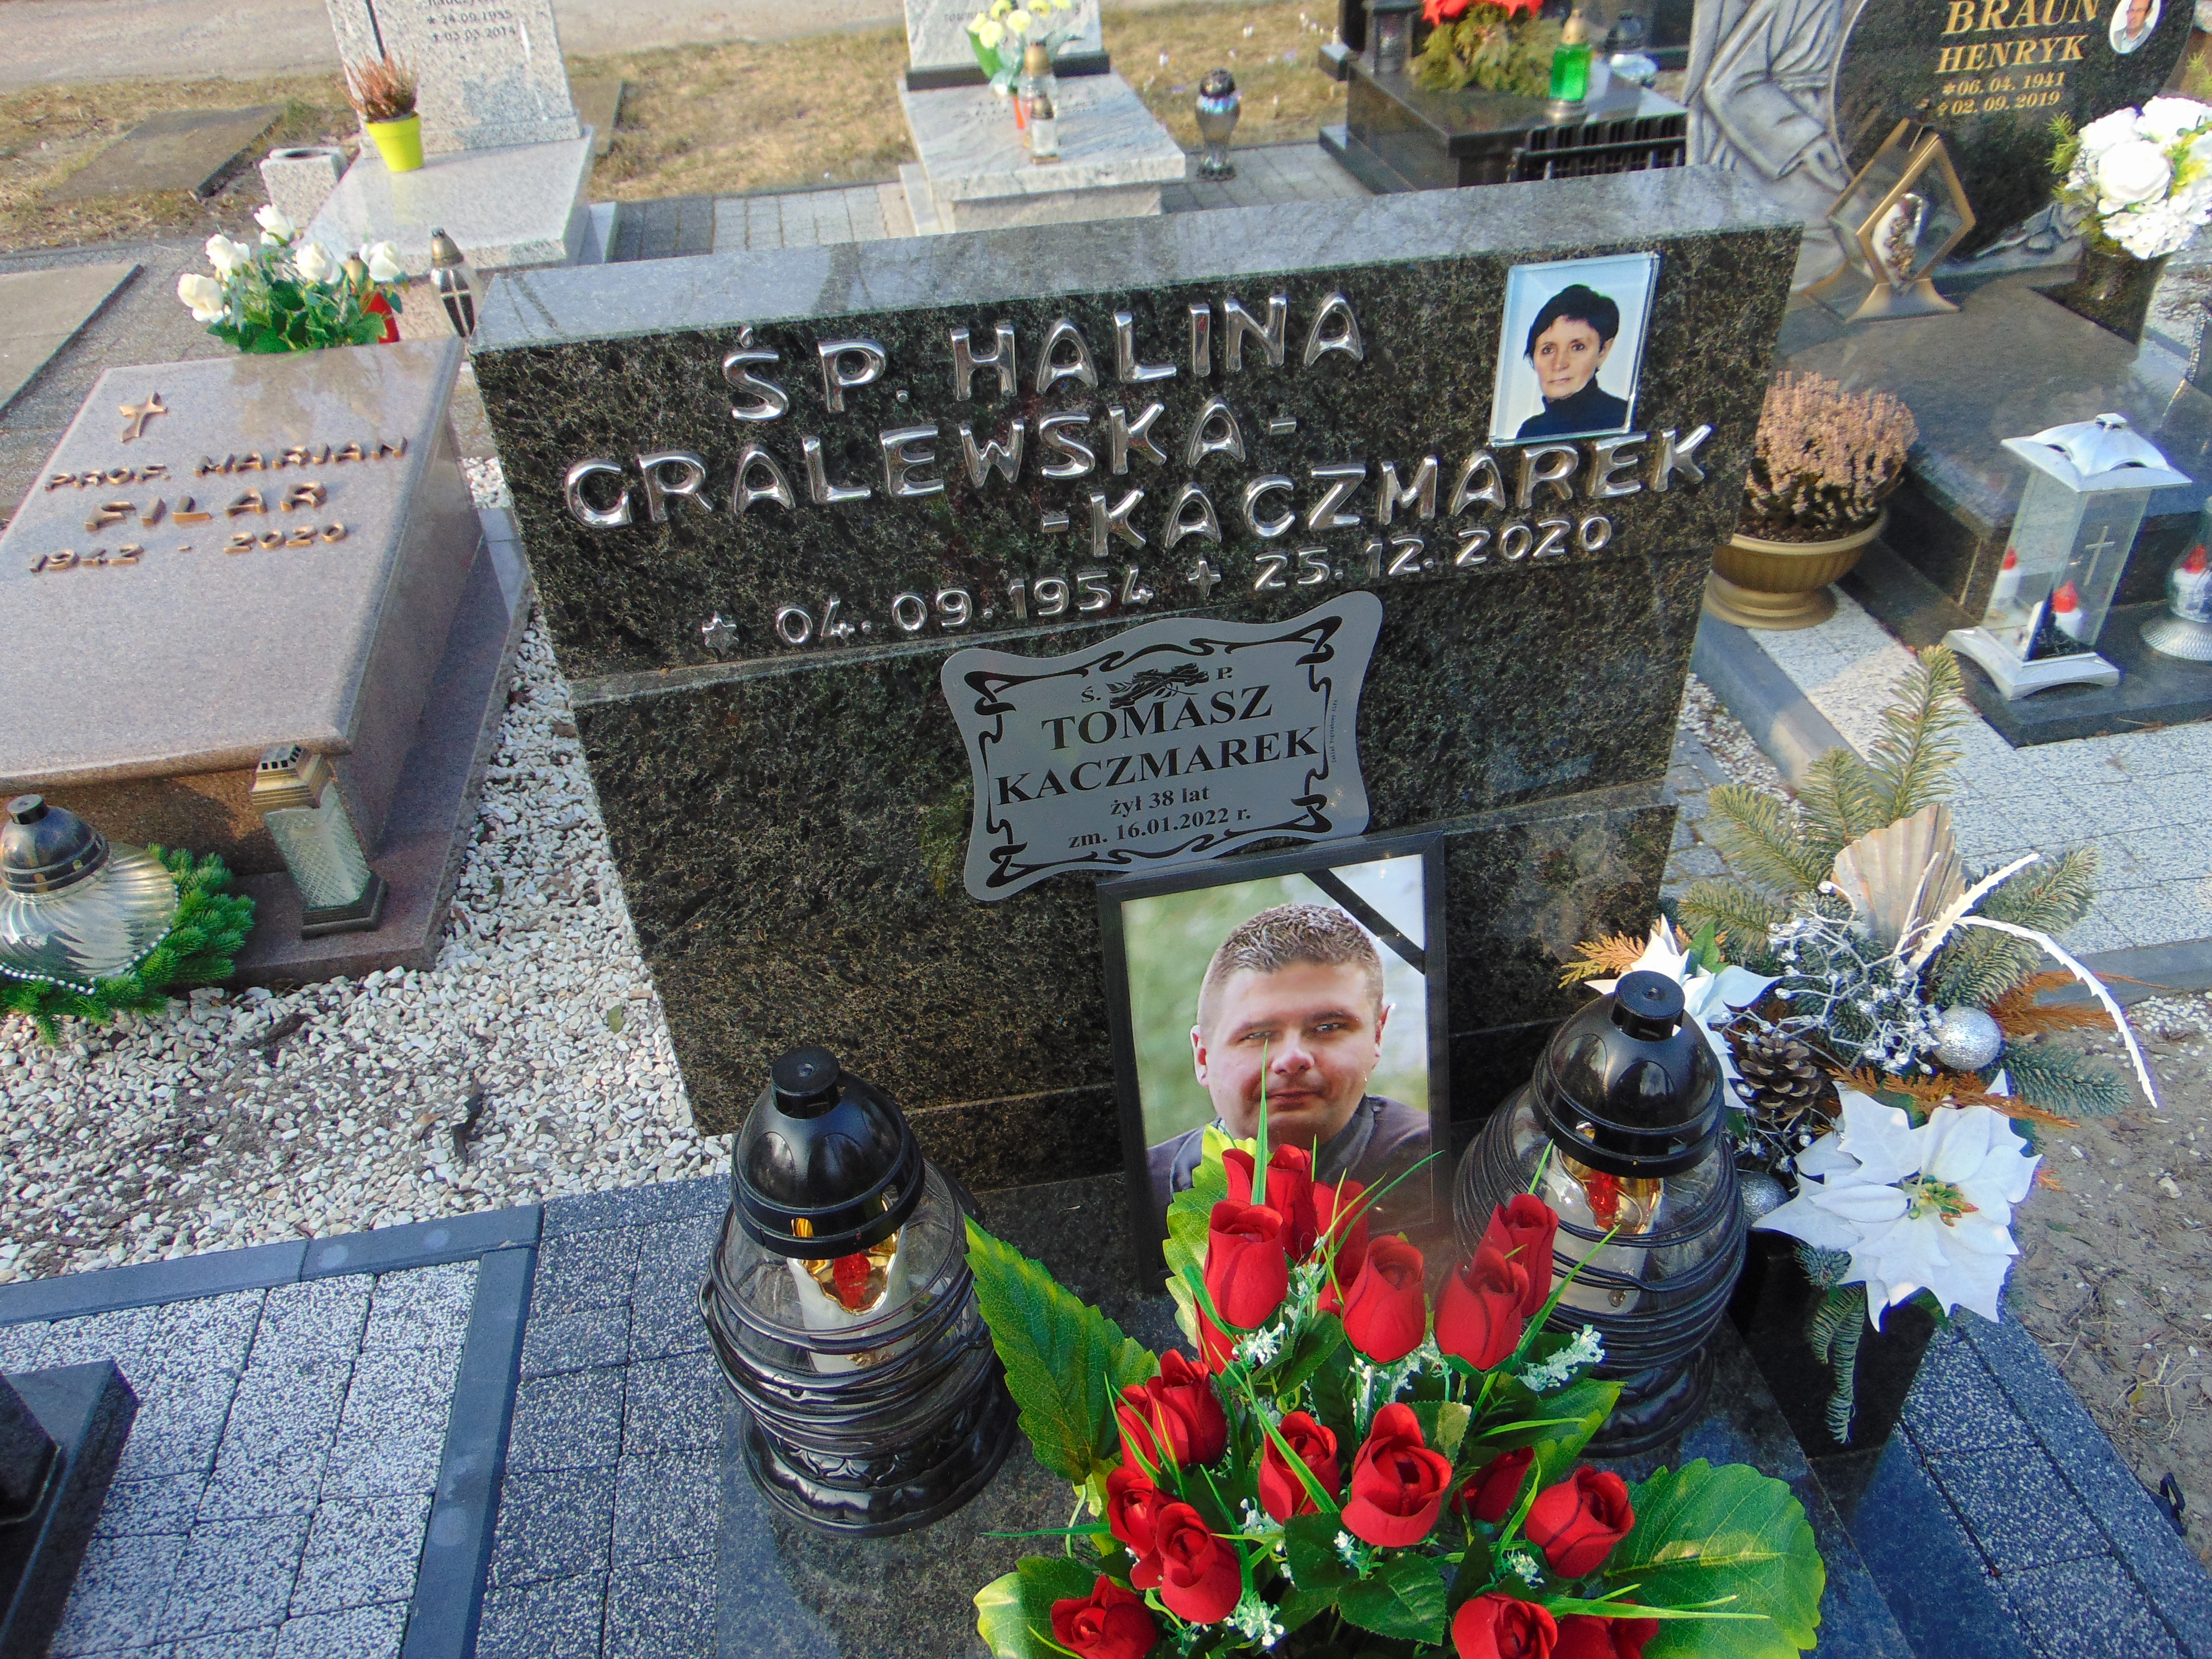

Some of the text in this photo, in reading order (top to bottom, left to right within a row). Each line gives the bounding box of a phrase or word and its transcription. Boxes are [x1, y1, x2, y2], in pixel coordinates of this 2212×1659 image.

[1941, 0, 2100, 35] BRAUN
[1934, 34, 2089, 73] HENRYK
[1952, 90, 2061, 115] 02. 09. 2019
[1957, 71, 2066, 95] 06. 04. 1941
[950, 291, 1364, 402] HALINA
[194, 436, 408, 477] MARIAN
[564, 395, 1297, 529] GRALEWSKA-
[85, 480, 328, 531] FILAR
[29, 542, 144, 572] 1942
[224, 521, 349, 554] 2020
[1216, 667, 1232, 680] P.
[1041, 684, 1272, 750] TOMASZ
[994, 726, 1319, 806] KACZMAREK
[1110, 785, 1210, 818] żył 38 lat
[1069, 806, 1251, 848] zm. 16.01.2022 r.
